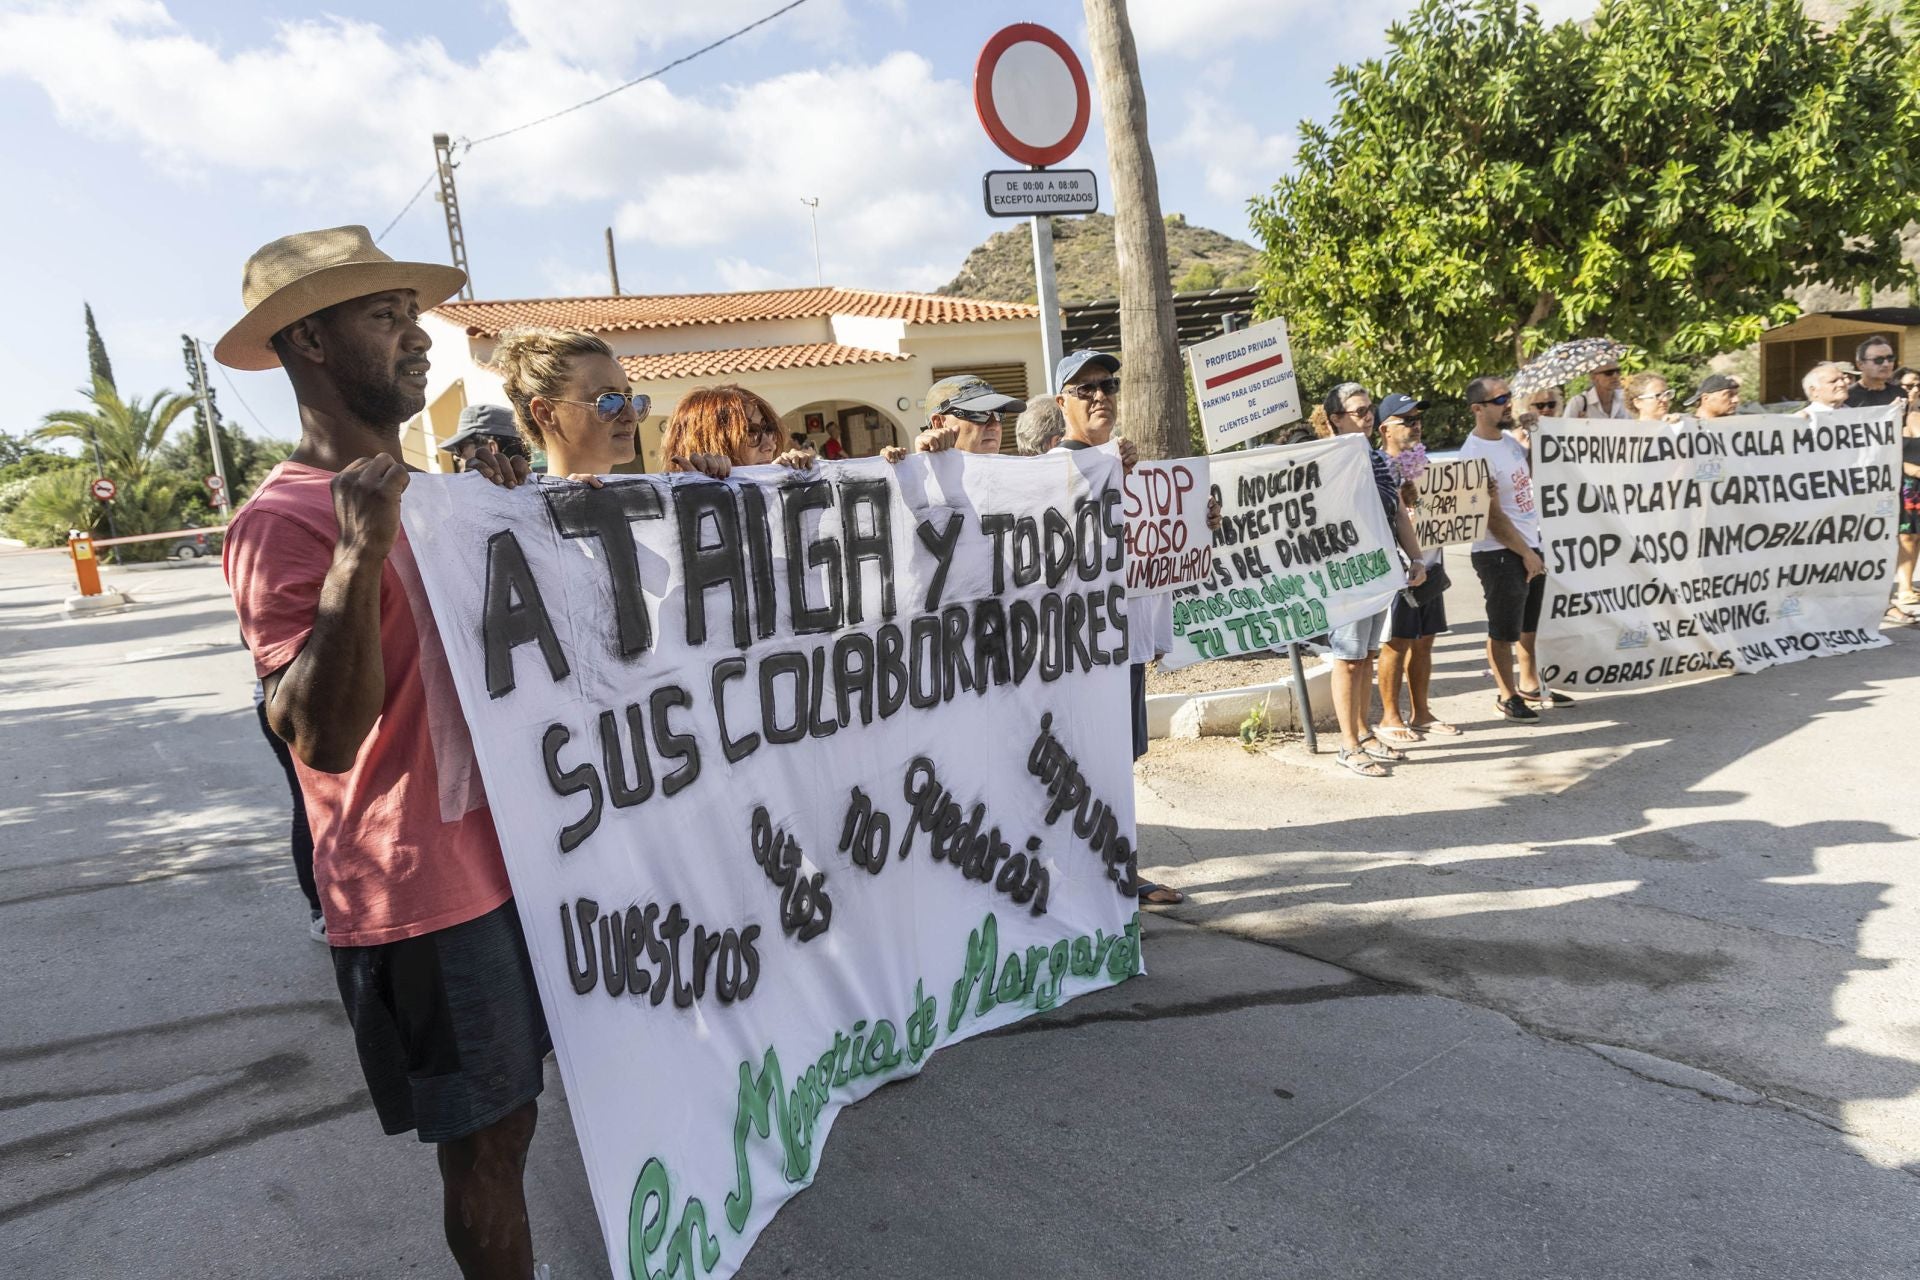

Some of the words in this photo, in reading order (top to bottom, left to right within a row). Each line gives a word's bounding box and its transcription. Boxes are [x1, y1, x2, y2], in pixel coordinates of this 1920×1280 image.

[994, 194, 1034, 205] EXCEPTO
[1035, 192, 1093, 204] AUTORIZADOS
[1006, 181, 1019, 191] DE
[1022, 181, 1044, 190] 00:00
[1048, 180, 1055, 190] A
[1058, 180, 1079, 190] 08:00
[1205, 347, 1247, 368] PROPIEDAD
[1247, 336, 1278, 354] PRIVADA
[1202, 393, 1231, 410] PARKING
[1231, 386, 1248, 400] PARA
[1248, 382, 1262, 393] USO
[1262, 370, 1294, 388] EXCLUSIVO
[1248, 398, 1257, 408] DE
[1218, 415, 1249, 433] CLIENTES
[1249, 411, 1262, 422] DEL
[1262, 400, 1289, 417] CAMPING
[1731, 430, 1785, 457] CALA
[1793, 420, 1896, 454] MORENA
[1123, 465, 1194, 518] STOP
[1420, 458, 1496, 496] JUSTICIA
[1541, 483, 1569, 518] ES
[1623, 479, 1702, 515] PLAYA
[1123, 518, 1188, 558] ACOSO
[1416, 514, 1485, 548] MARGARET
[1551, 533, 1622, 574] STOP
[1697, 514, 1889, 559] INMOBILIARIO.
[1230, 545, 1272, 581] DEL
[1680, 568, 1770, 604] DERECHOS
[1777, 558, 1887, 588] HUMANOS
[482, 528, 571, 701] A
[540, 477, 898, 657] TAIGA
[915, 512, 965, 613] Y
[980, 488, 1125, 597] TODOS
[1172, 592, 1233, 636] gemos
[1326, 548, 1392, 591] FUERZA
[1187, 627, 1229, 660] TU
[1676, 619, 1699, 638] EL
[1563, 670, 1579, 684] A
[1584, 658, 1655, 685] OBRAS
[542, 684, 702, 854] SUS
[711, 584, 1130, 764] COLABORADORES
[838, 785, 891, 876] no
[1026, 711, 1138, 898] impunes
[906, 978, 939, 1065] de
[948, 912, 1141, 1034] Margaret
